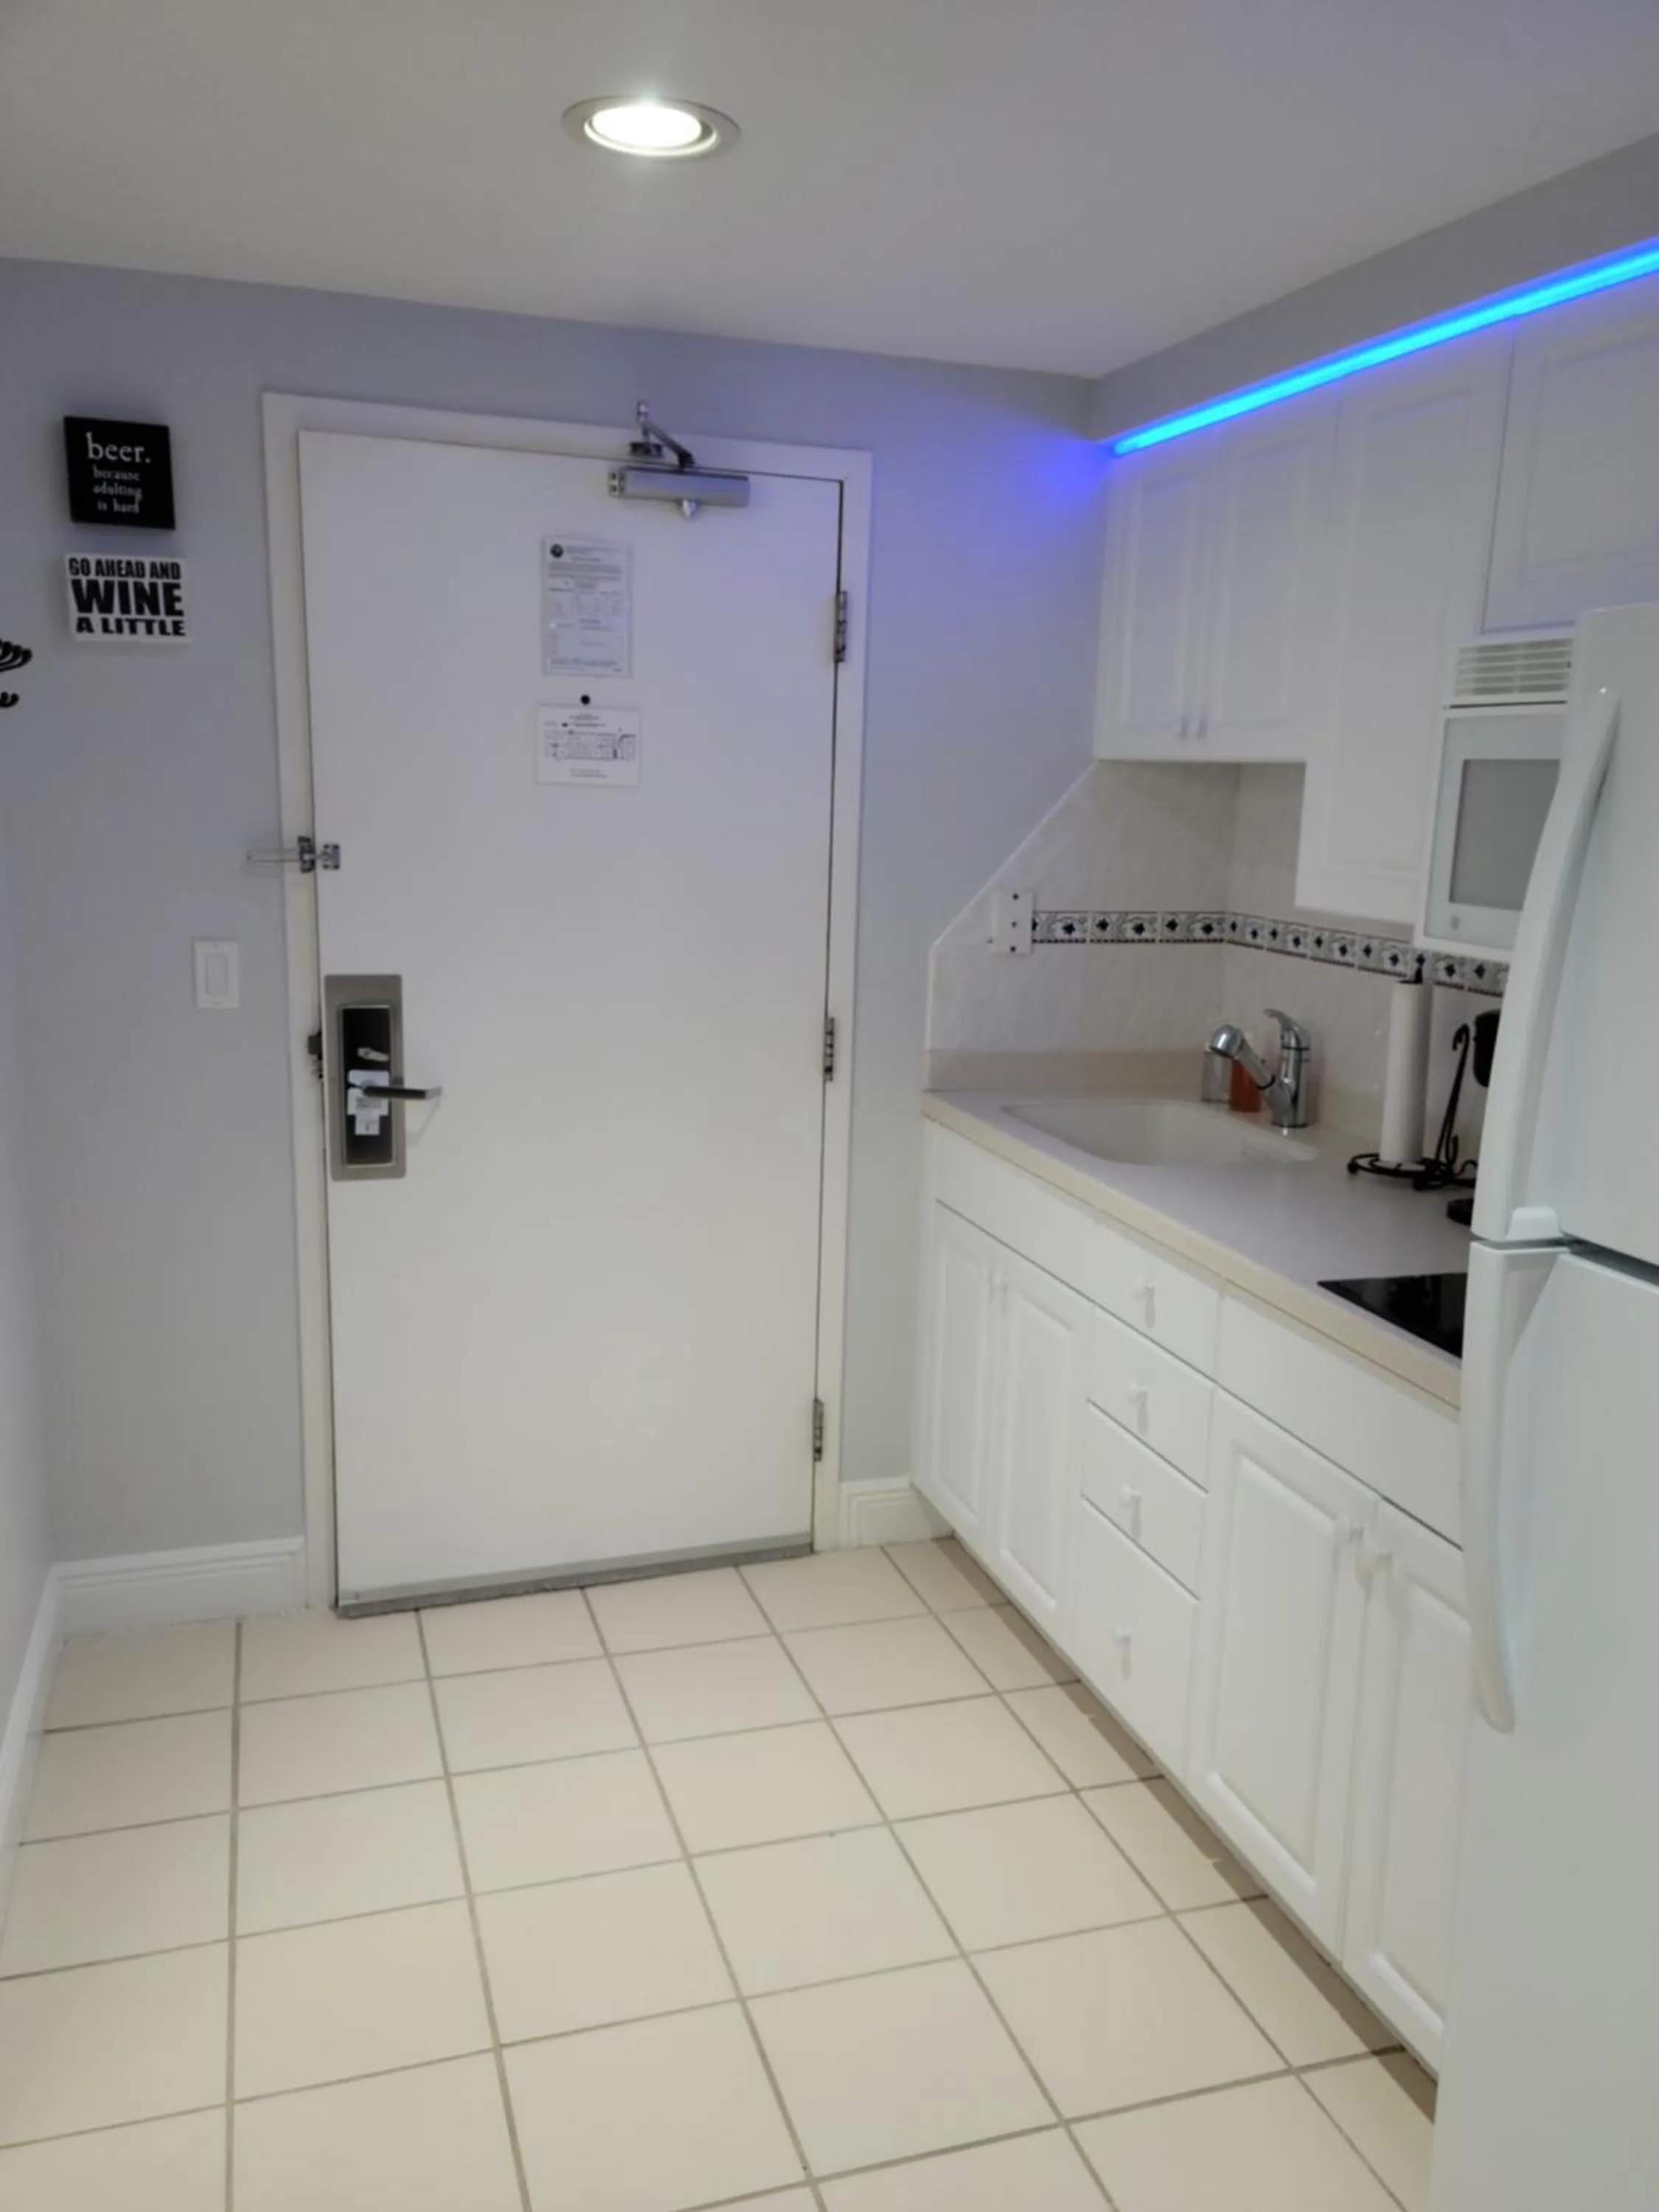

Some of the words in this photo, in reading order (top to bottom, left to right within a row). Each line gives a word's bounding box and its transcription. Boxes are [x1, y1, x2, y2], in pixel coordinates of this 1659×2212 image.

[86, 431, 151, 463] beer.
[93, 465, 140, 481] because
[93, 481, 142, 500] adulting
[97, 501, 108, 511] is
[113, 498, 139, 513] hard
[69, 557, 91, 577] GO
[95, 559, 145, 579] AHEAD
[150, 561, 181, 580] AND
[72, 579, 184, 617] WINE
[75, 617, 94, 633] A
[101, 617, 186, 636] LITTLE
